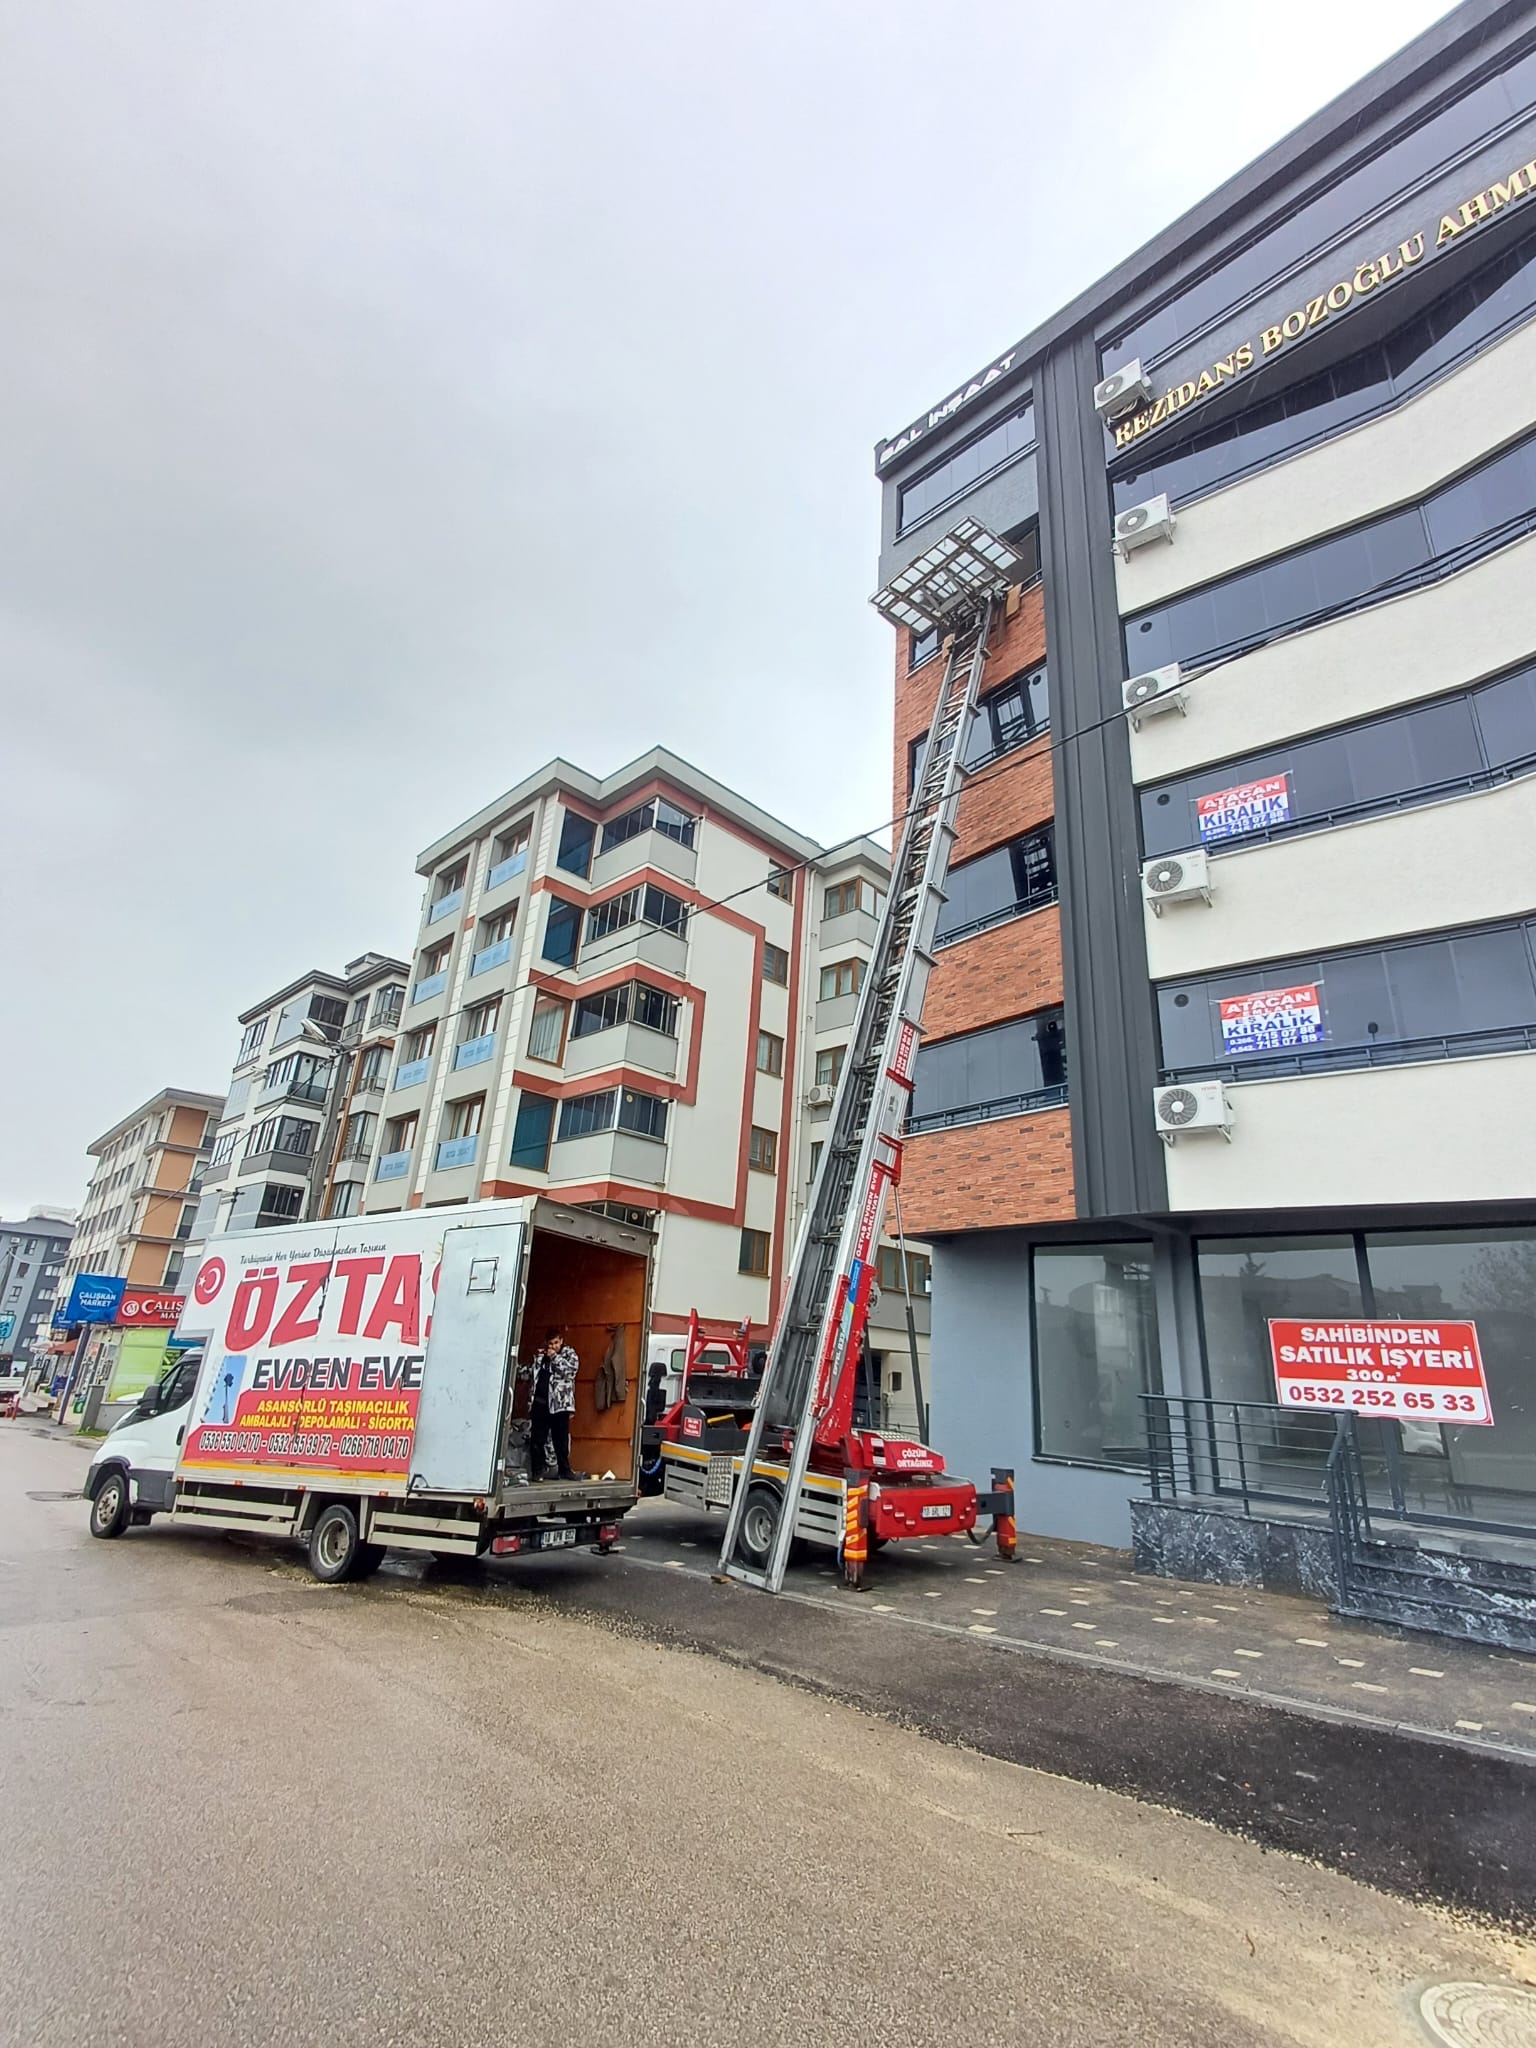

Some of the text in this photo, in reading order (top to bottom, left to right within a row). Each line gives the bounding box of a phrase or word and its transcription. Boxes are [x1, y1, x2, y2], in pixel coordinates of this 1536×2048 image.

[1115, 342, 1254, 448] REZİDANS
[1260, 231, 1425, 356] BOZOĞLU
[1203, 781, 1280, 810] ATACAN
[1226, 992, 1311, 1014] ATACAN
[1256, 1031, 1278, 1042] 715
[1281, 1028, 1297, 1038] 07
[1256, 1039, 1280, 1049] 715
[1282, 1036, 1298, 1046] 07
[80, 1299, 112, 1308] MARKET
[225, 1253, 441, 1351] ÖZTA
[1300, 1324, 1441, 1346] SAHİBİNDEN
[1280, 1344, 1475, 1370] SATILIK İŞYERİ
[252, 1355, 425, 1389] EVDEN EVE
[1346, 1369, 1384, 1382] 300
[330, 1400, 410, 1416] TAŞIMACILIK
[1289, 1385, 1476, 1412] 0532 252 65 33
[239, 1414, 291, 1428] AMBALAJLI
[298, 1415, 360, 1429] DEPOLAMALI
[268, 1433, 290, 1454] 0532
[396, 1438, 409, 1458] 70
